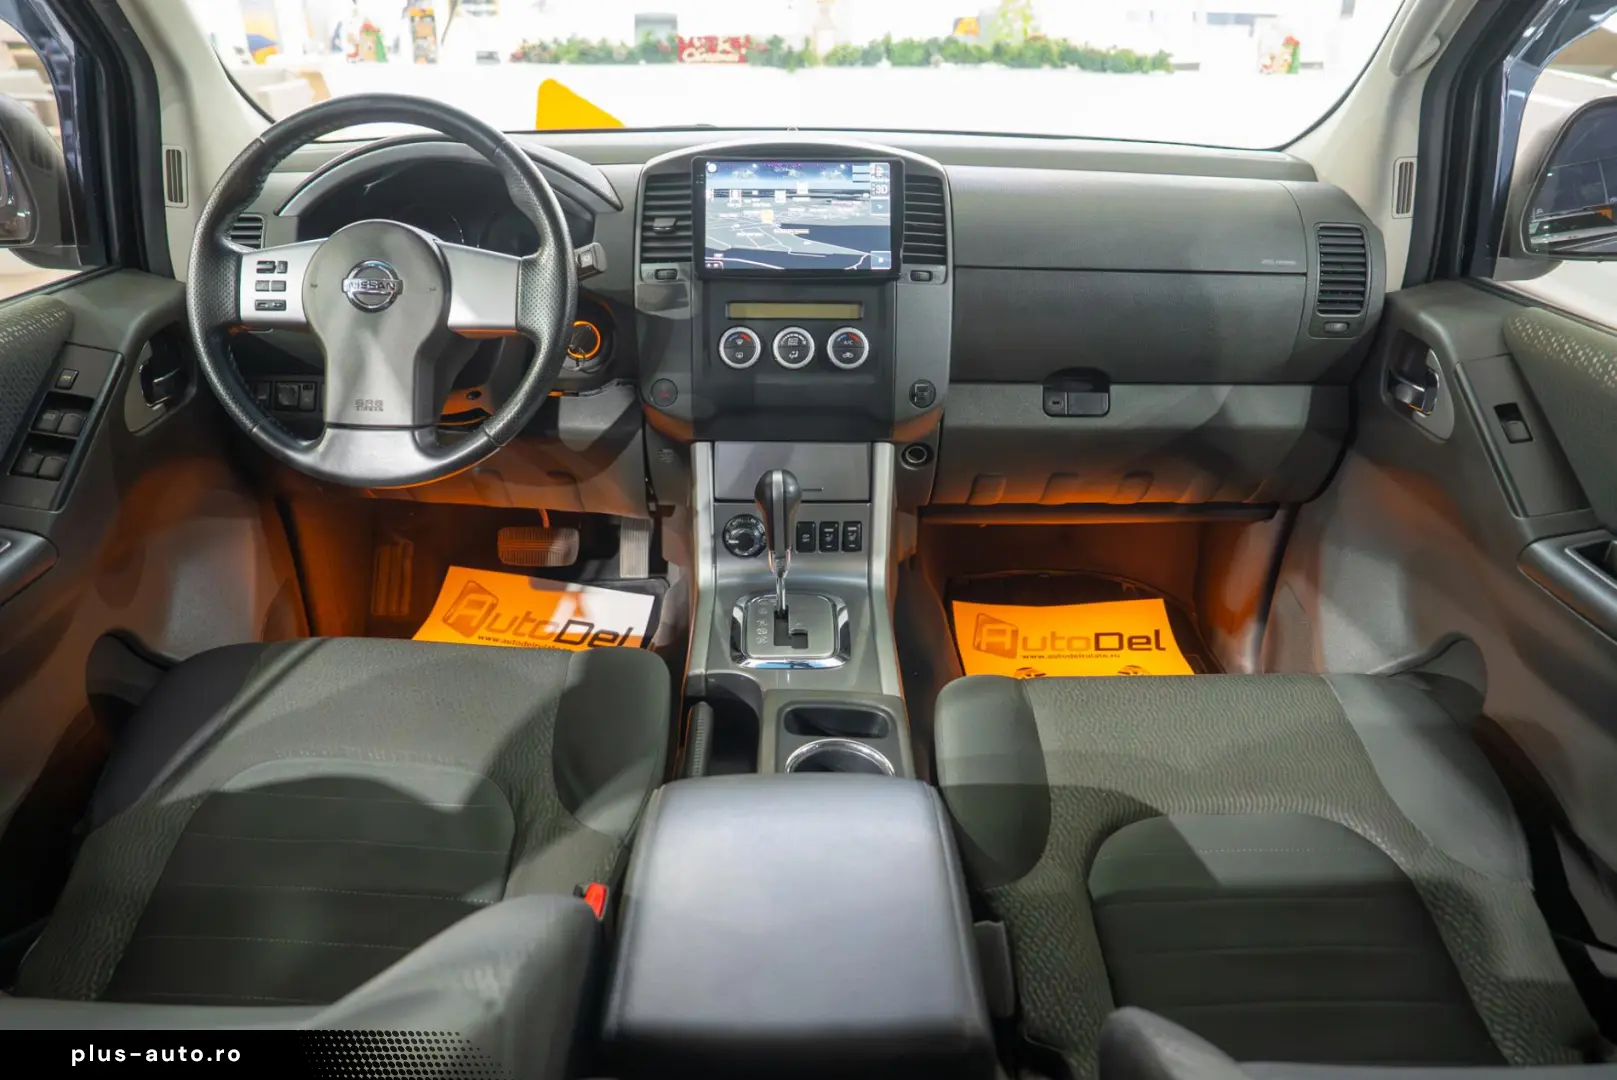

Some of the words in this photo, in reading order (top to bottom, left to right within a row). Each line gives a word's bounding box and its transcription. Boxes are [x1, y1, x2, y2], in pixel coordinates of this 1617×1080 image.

[348, 279, 397, 291] NISSAN
[442, 580, 633, 647] AutoDel
[972, 613, 1166, 659] AutoDel
